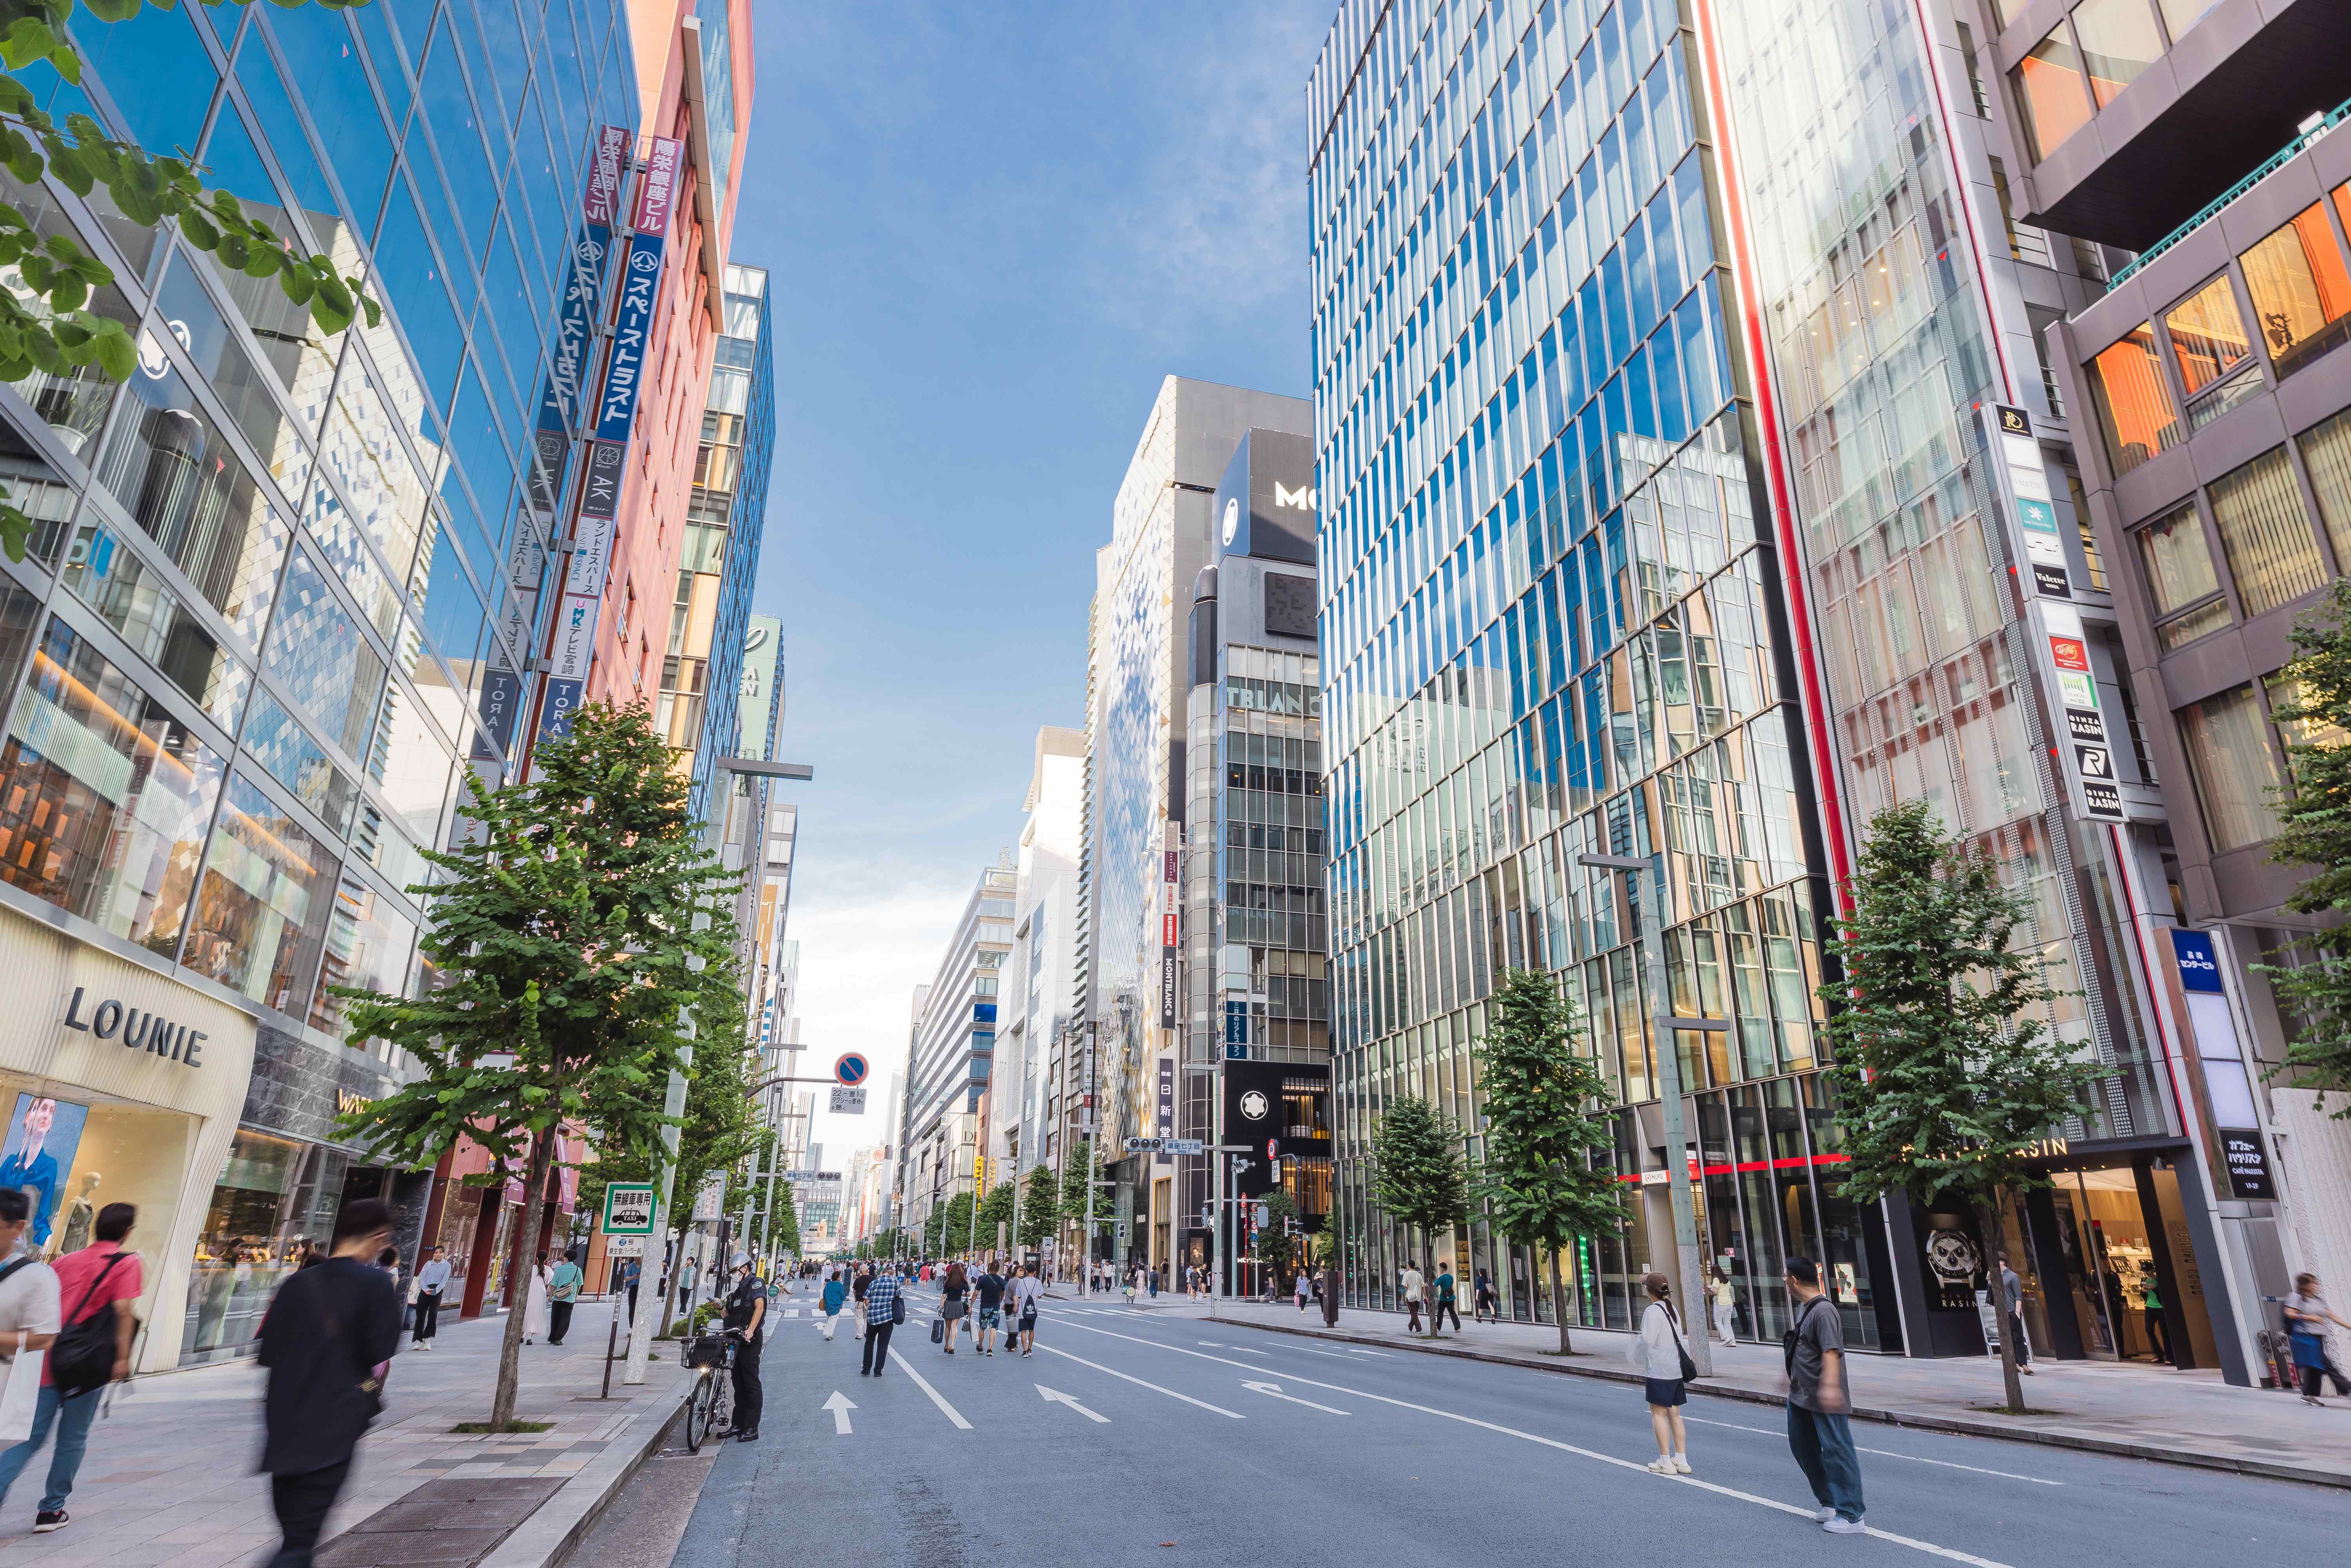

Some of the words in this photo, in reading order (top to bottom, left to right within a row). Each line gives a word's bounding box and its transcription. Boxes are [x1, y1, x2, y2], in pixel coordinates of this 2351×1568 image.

[640, 139, 677, 231] 陽栄銀座ビル
[604, 277, 657, 423] スペーストラスト
[590, 475, 614, 500] AK
[578, 527, 589, 548] LAND
[571, 555, 583, 582] ESPACE
[2035, 572, 2066, 585] Valette
[2069, 715, 2100, 725] GINZA
[2070, 722, 2103, 735] RASIN
[2086, 789, 2118, 799] GINZA
[2087, 797, 2121, 809] RASIN
[2180, 959, 2214, 970] センタービル
[1165, 958, 1173, 1009] MONTBLANC
[64, 987, 208, 1068] LOUNIE
[1159, 1084, 1171, 1138] 日新堂
[613, 1192, 651, 1206] 無線車専用
